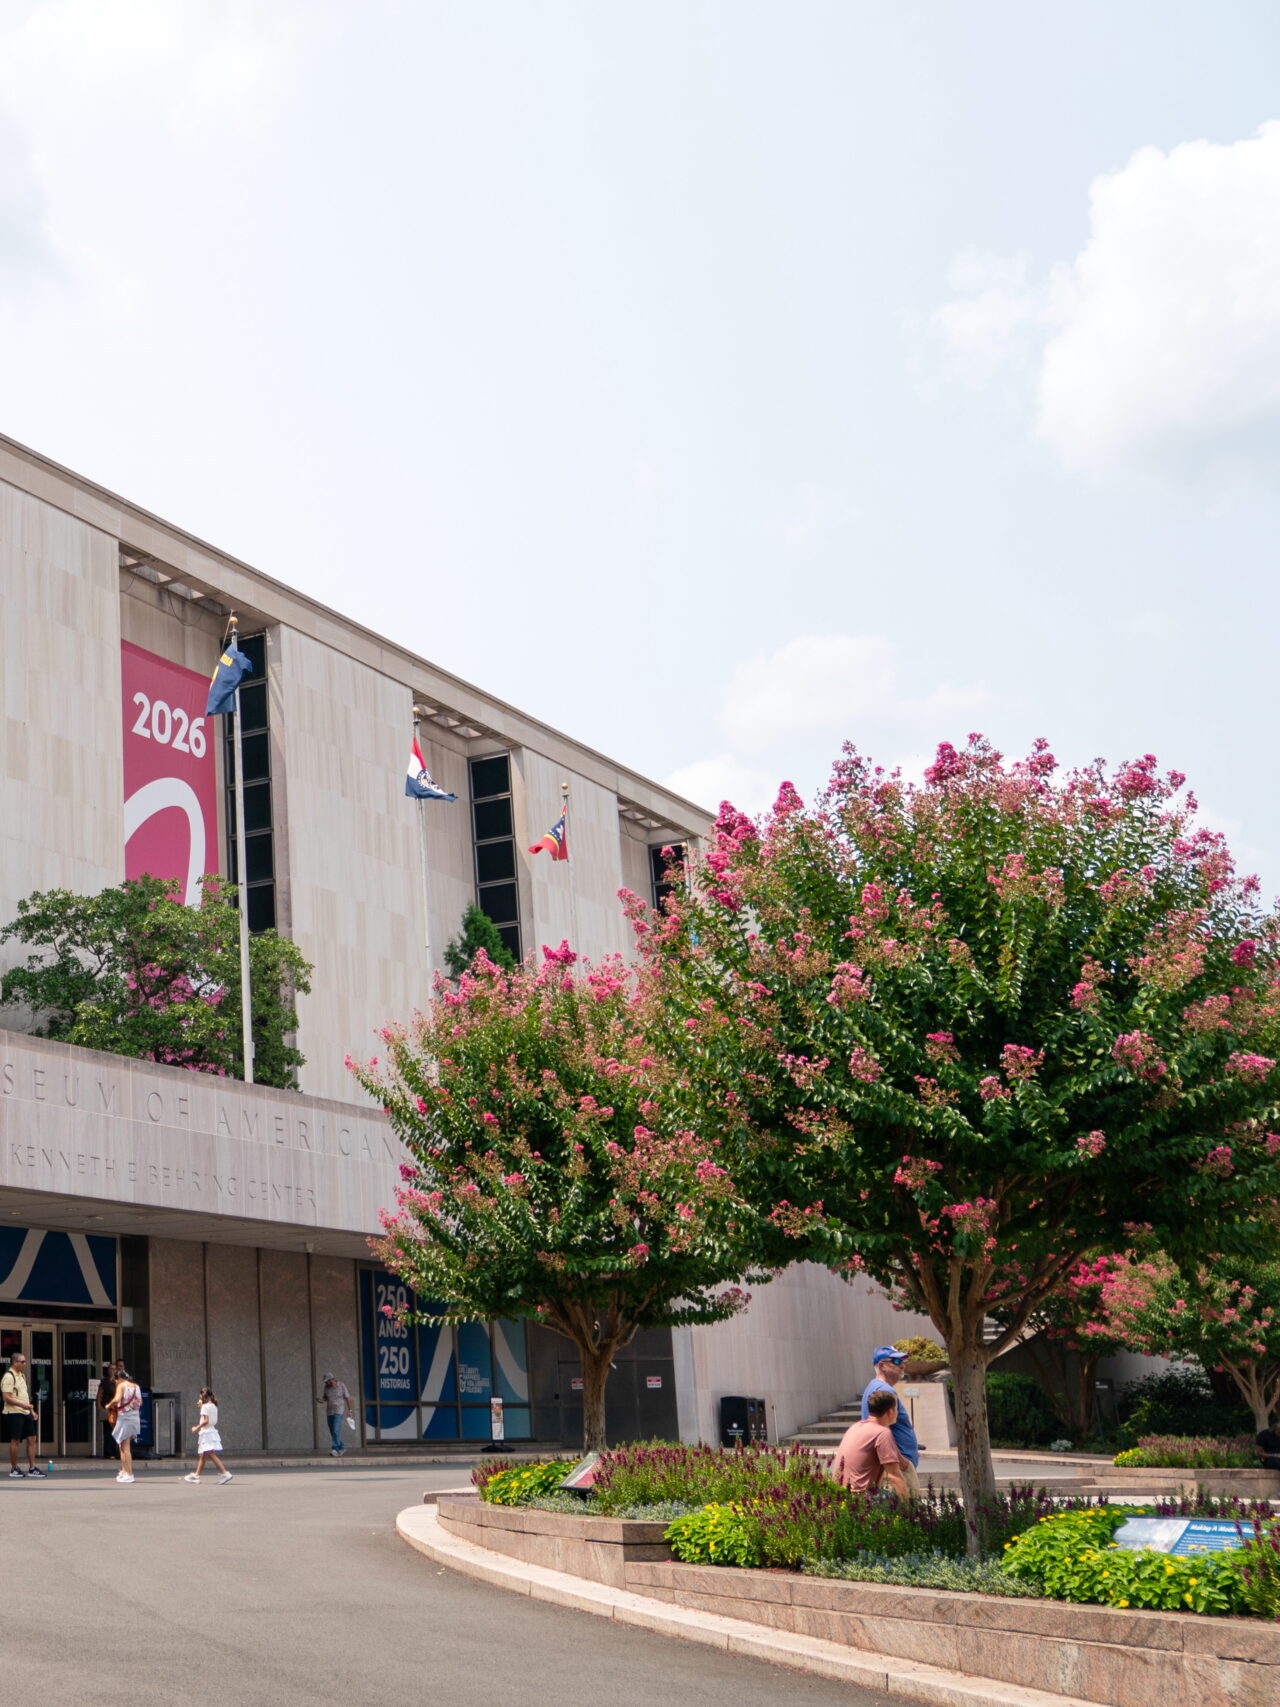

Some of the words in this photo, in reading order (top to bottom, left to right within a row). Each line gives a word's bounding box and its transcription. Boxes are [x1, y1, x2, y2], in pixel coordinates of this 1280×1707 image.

[131, 691, 207, 758] 2026
[146, 1091, 189, 1122] OF
[216, 1106, 396, 1162] AMERICAN
[11, 1143, 116, 1177] KENNETH
[149, 1165, 238, 1197] BEHRING
[248, 1179, 317, 1208] CENTER
[377, 1284, 407, 1314] 250
[379, 1346, 410, 1375] 250
[380, 1378, 411, 1390] HISTORIAS
